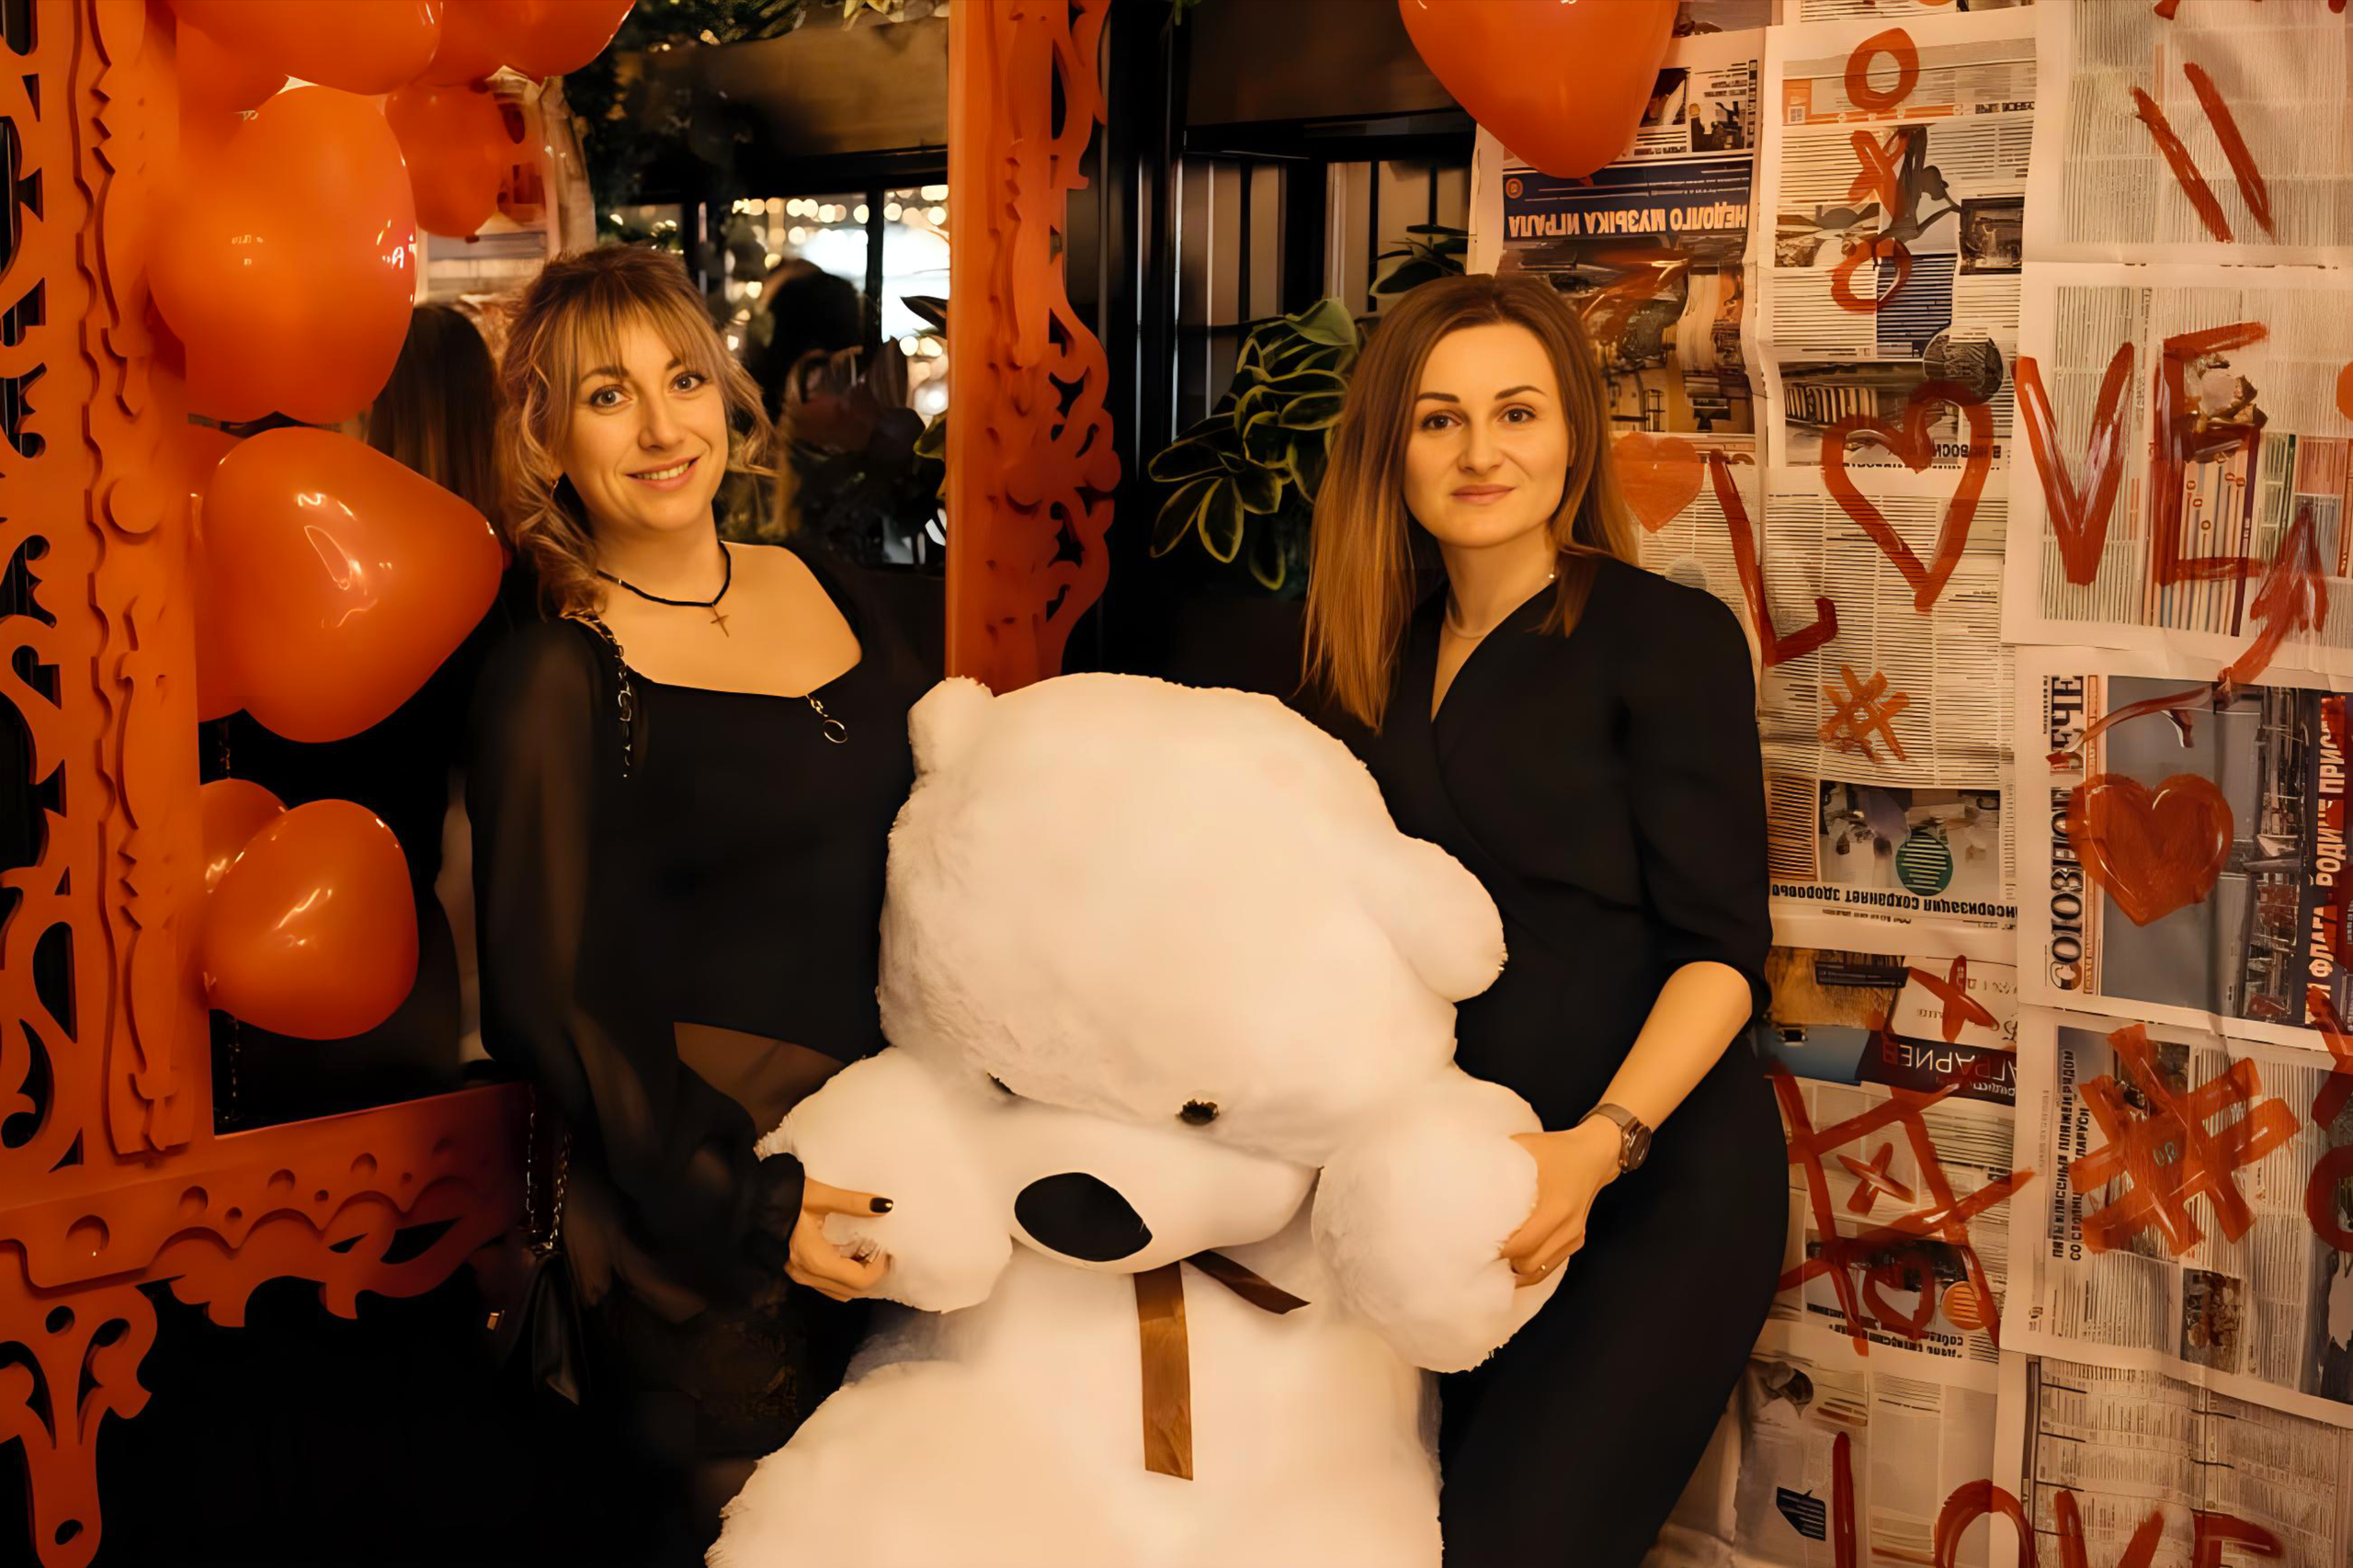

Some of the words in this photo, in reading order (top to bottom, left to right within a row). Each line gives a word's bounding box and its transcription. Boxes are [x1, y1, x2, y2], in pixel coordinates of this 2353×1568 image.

[1507, 212, 1580, 238] ИГРАЛА
[1584, 208, 1666, 234] МУЗЫКА
[1669, 201, 1747, 231] НЕДОЛГО
